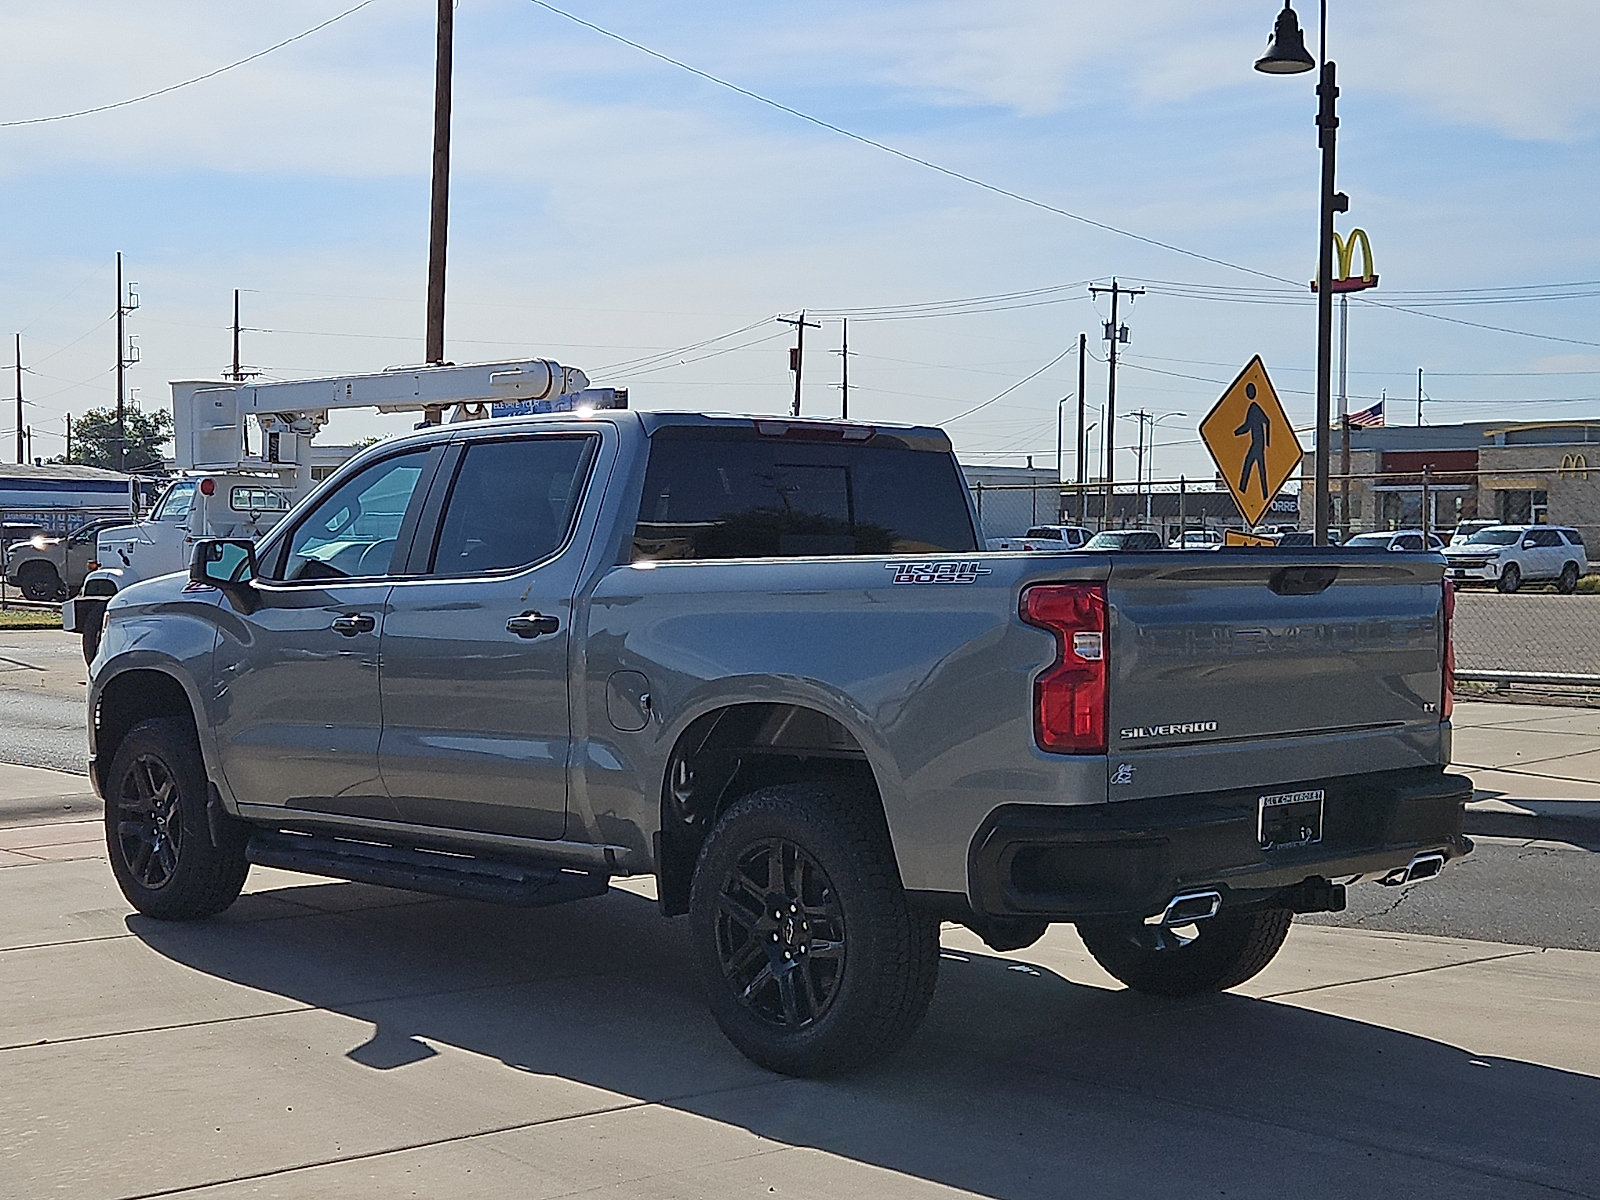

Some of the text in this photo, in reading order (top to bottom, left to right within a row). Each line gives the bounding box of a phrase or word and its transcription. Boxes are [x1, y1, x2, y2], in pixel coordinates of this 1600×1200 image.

[885, 562, 992, 575] TRAIL
[893, 573, 977, 584] BOSS
[1120, 721, 1218, 739] SILVERADO
